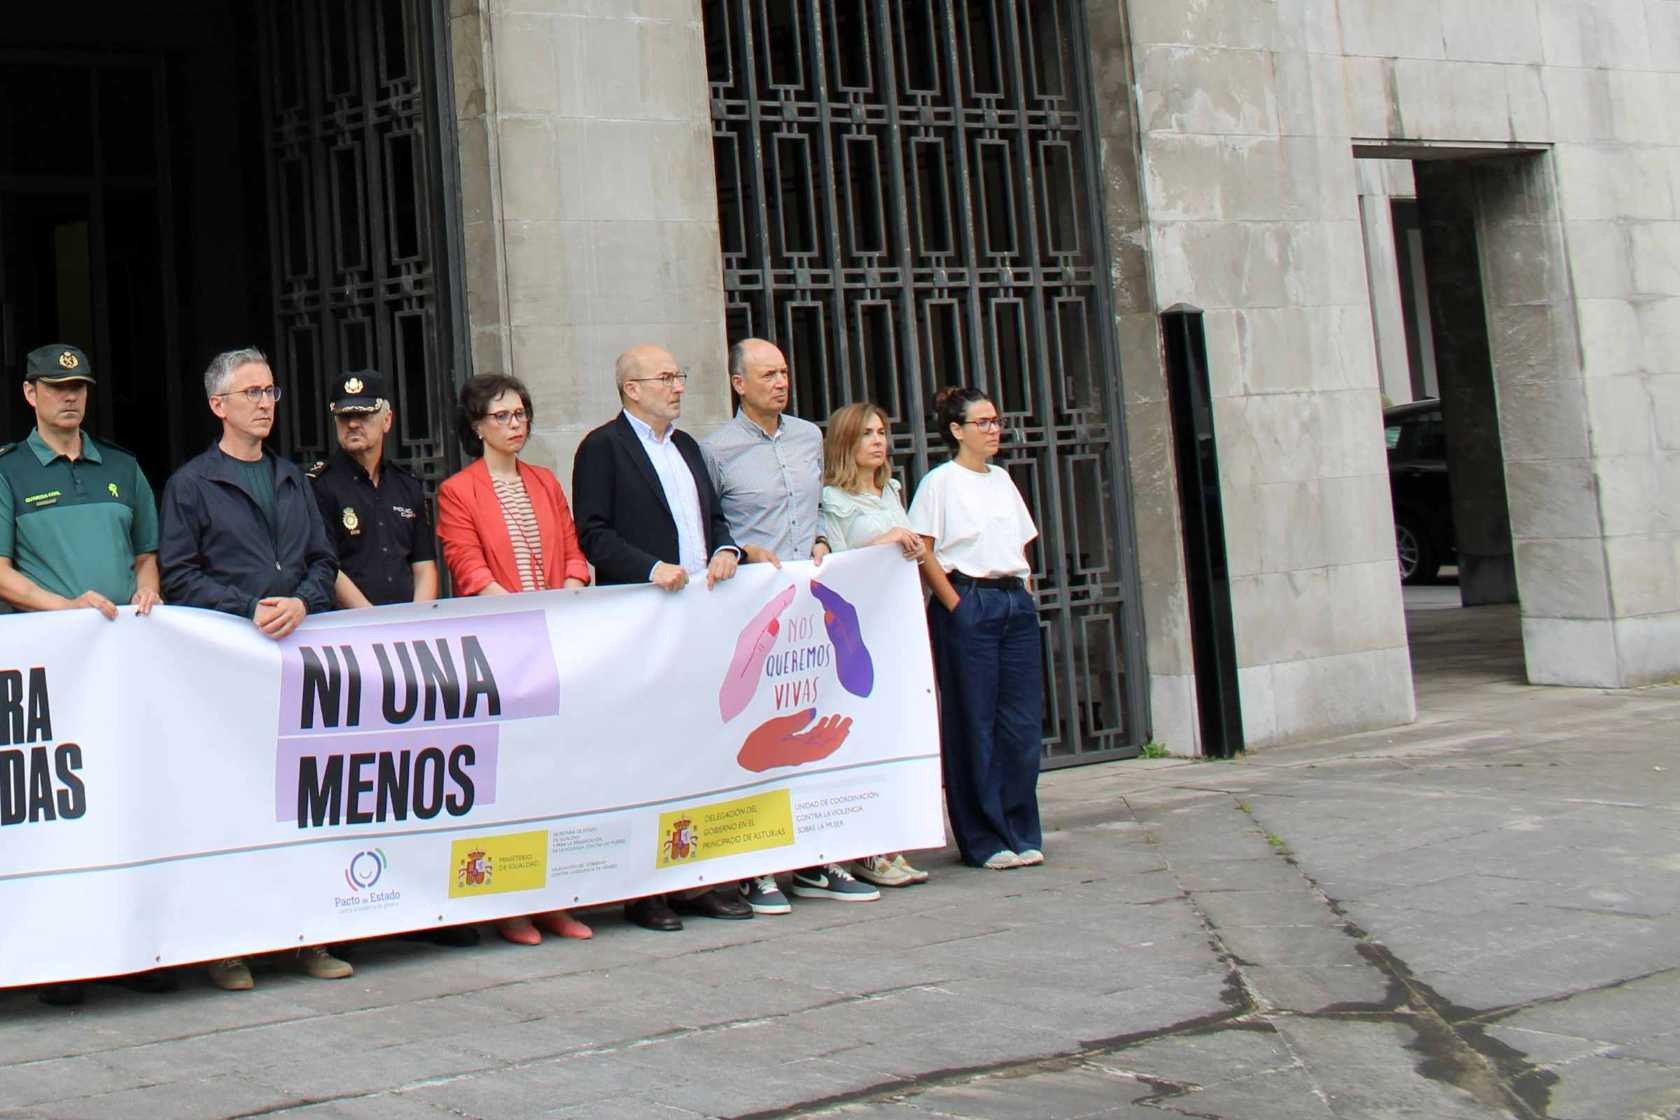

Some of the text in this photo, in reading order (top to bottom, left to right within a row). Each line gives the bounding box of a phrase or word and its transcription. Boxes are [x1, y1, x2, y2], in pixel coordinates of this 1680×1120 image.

[788, 614, 816, 643] NOS
[766, 643, 831, 677] QUEREMOS
[298, 635, 502, 729] NI UNA
[774, 676, 819, 711] VIVAS
[298, 744, 476, 828] MENOS
[334, 896, 361, 907] Pacto
[370, 888, 401, 903] Estado
